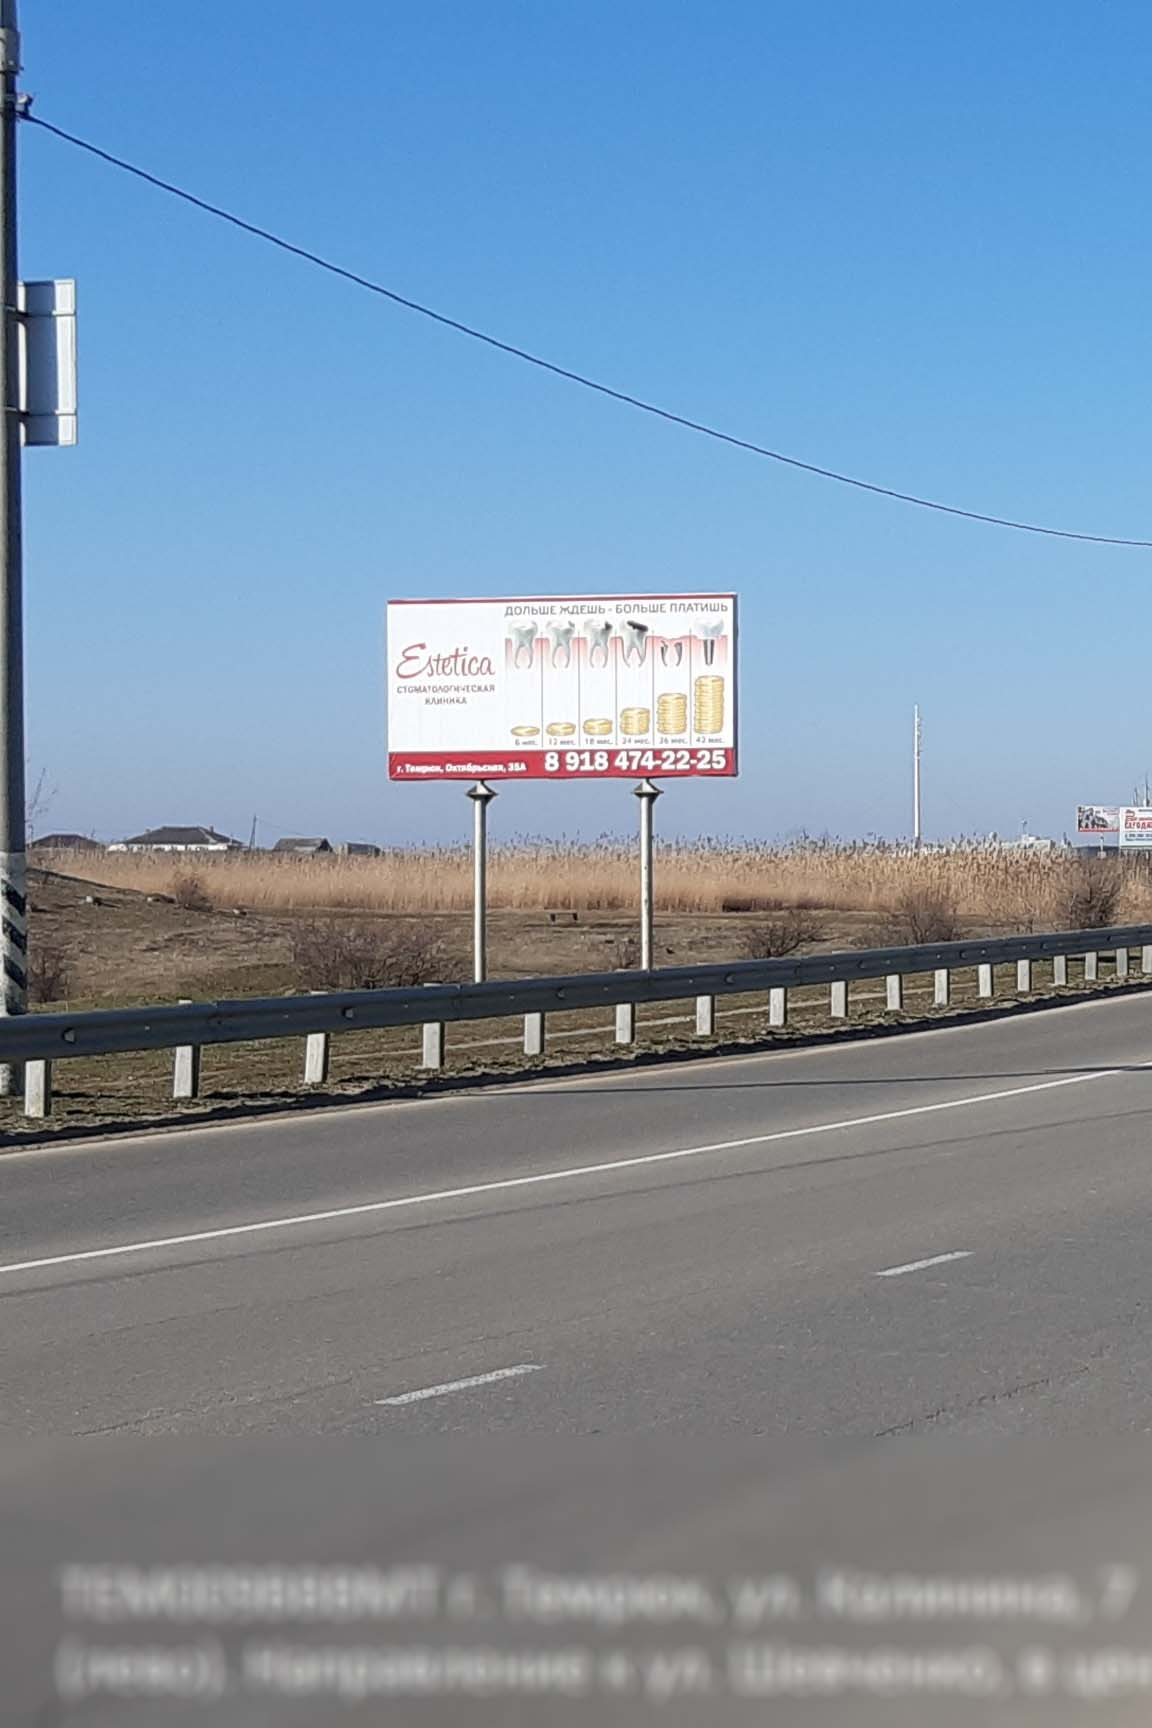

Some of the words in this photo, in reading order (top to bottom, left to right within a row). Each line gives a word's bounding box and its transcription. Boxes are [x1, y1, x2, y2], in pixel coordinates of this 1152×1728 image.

[504, 605, 557, 617] ДОЛЬШЕ
[559, 604, 605, 617] ЖДЕШЬ
[615, 603, 666, 615] БОЛЬШЕ
[669, 602, 728, 614] ПЛАТИШЬ
[395, 642, 496, 679] Estetica
[396, 684, 496, 694] СТОМАТОЛОГИЧЕСКАЯ
[424, 696, 468, 705] КЛИНИКА
[544, 751, 560, 771] 8
[565, 751, 608, 771] 918
[614, 749, 726, 770] 474-22-25
